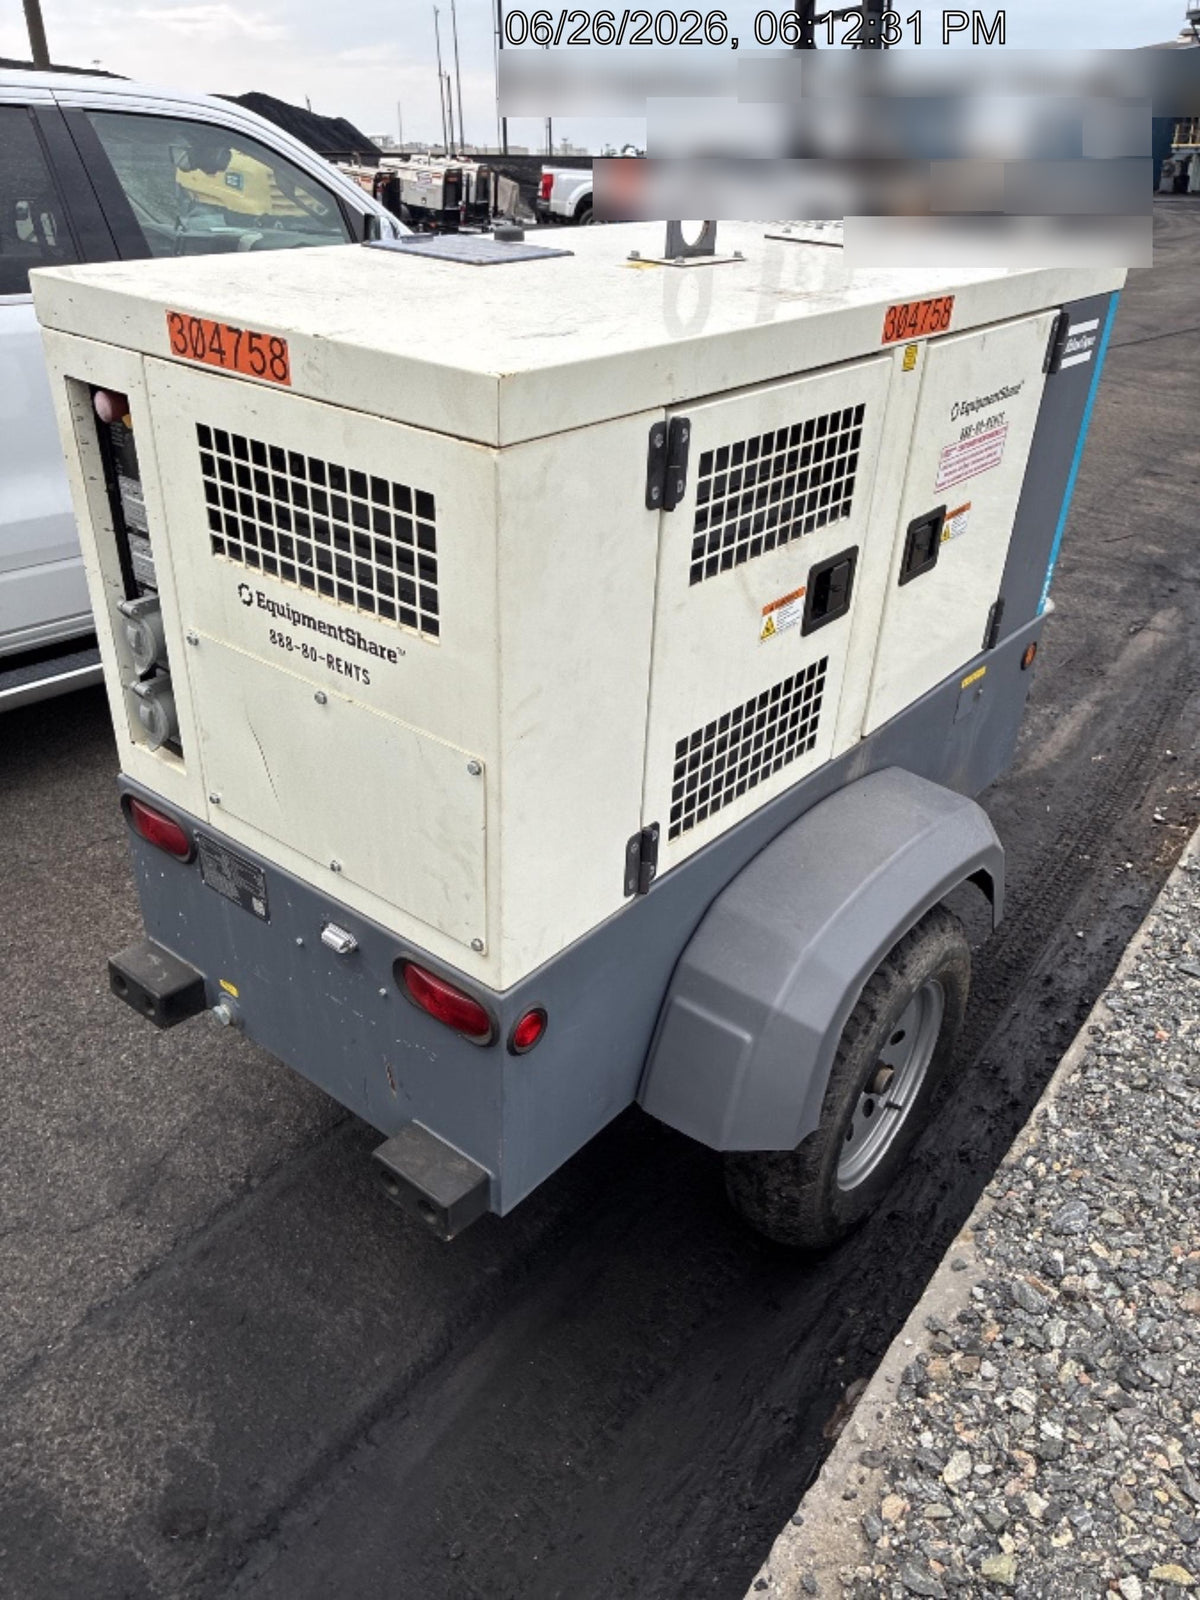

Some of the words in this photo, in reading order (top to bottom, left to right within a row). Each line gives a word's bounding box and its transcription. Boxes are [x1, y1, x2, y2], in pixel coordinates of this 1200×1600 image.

[169, 312, 288, 381] 304758
[884, 295, 954, 341] 304758
[269, 628, 371, 686] 888-80-RENTS
